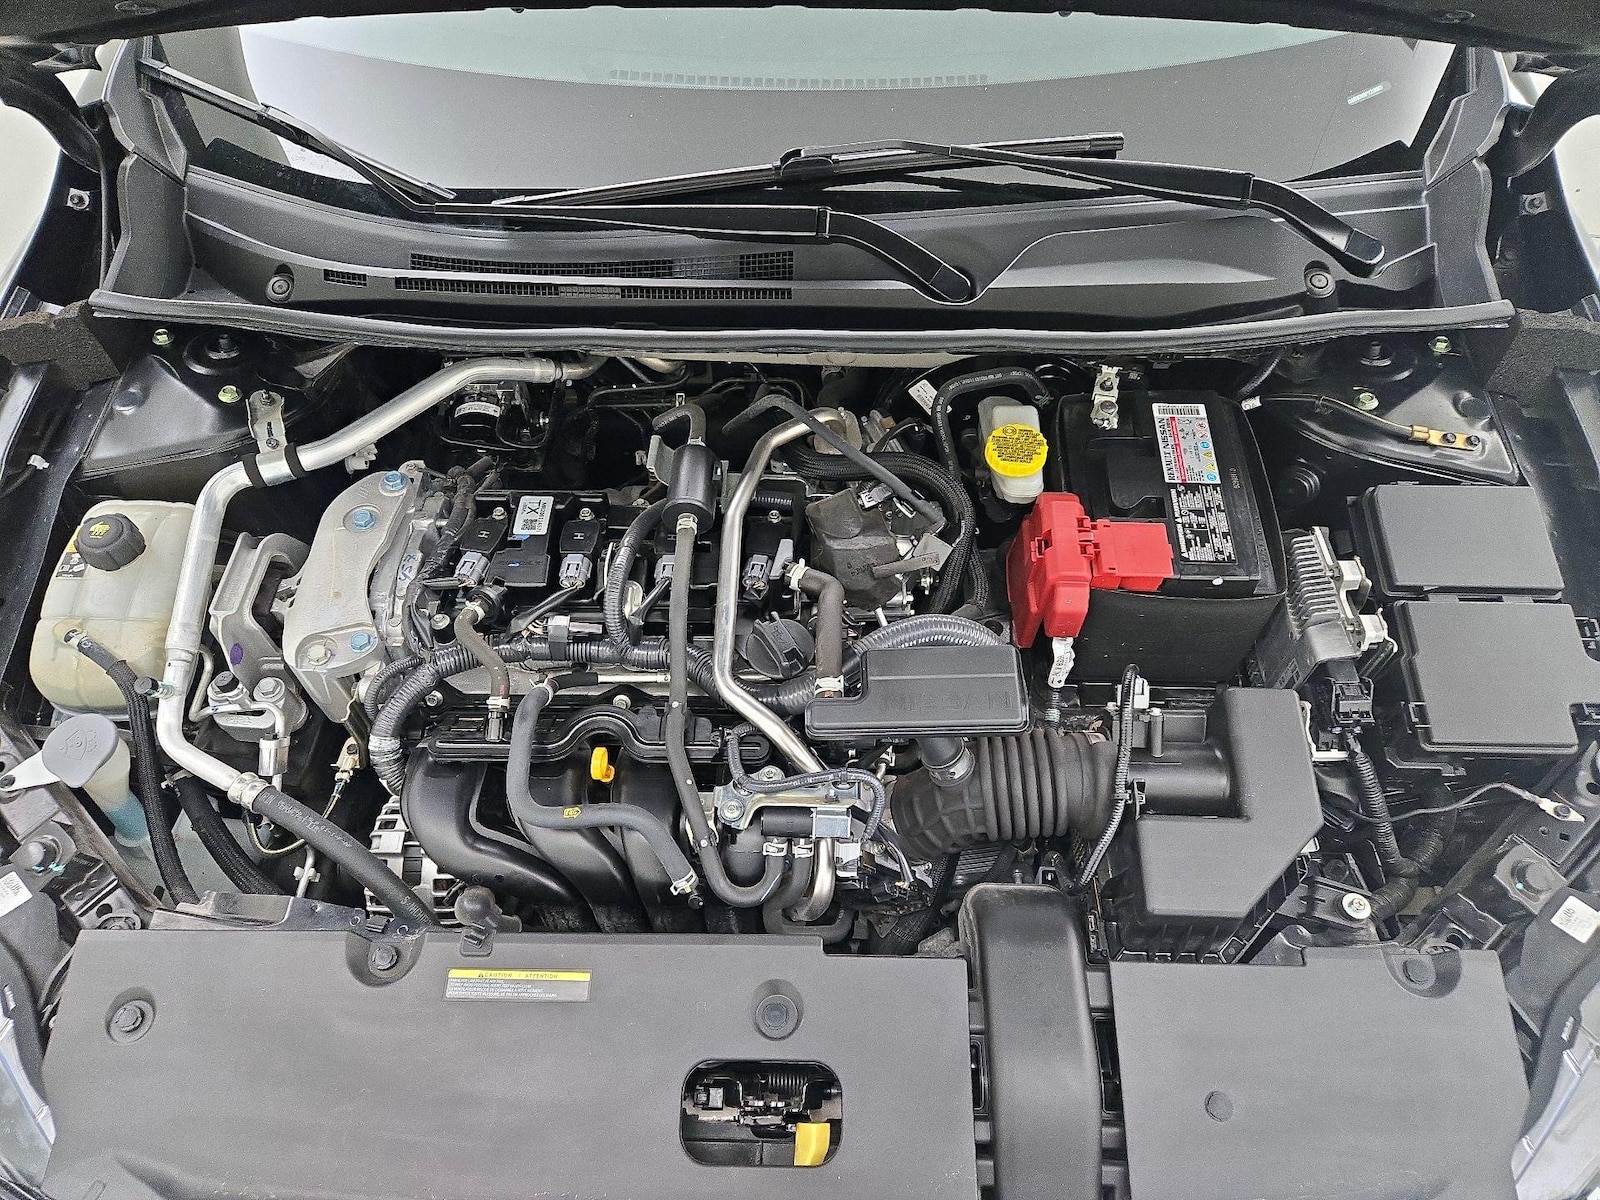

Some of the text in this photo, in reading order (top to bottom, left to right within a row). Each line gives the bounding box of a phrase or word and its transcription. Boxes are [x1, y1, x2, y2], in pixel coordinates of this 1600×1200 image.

[1157, 417, 1170, 449] NISSAN
[1164, 450, 1176, 481] RENAULT
[526, 499, 542, 515] TX
